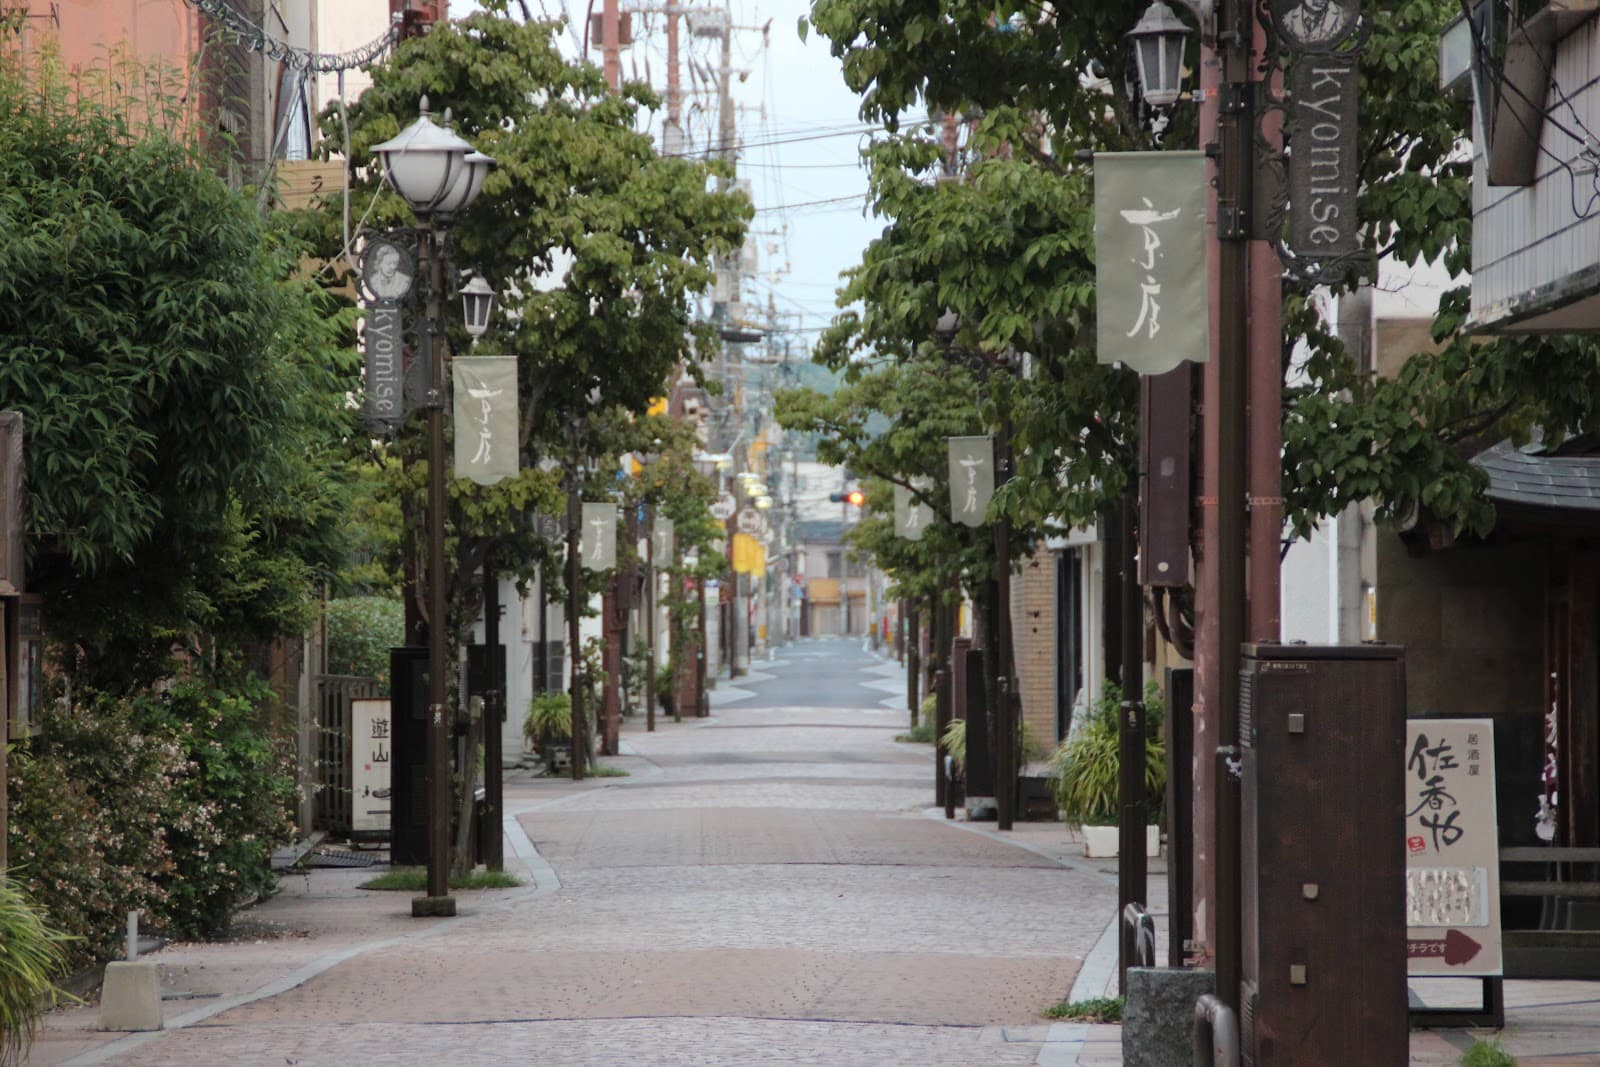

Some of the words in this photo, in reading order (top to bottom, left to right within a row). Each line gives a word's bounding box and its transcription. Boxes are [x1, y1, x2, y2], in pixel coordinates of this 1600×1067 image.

[1299, 67, 1350, 244] kyomise
[368, 308, 398, 412] kyomise
[1407, 733, 1464, 852] 佐香や
[1467, 733, 1480, 776] 居酒屋
[1407, 943, 1447, 953] チラです
